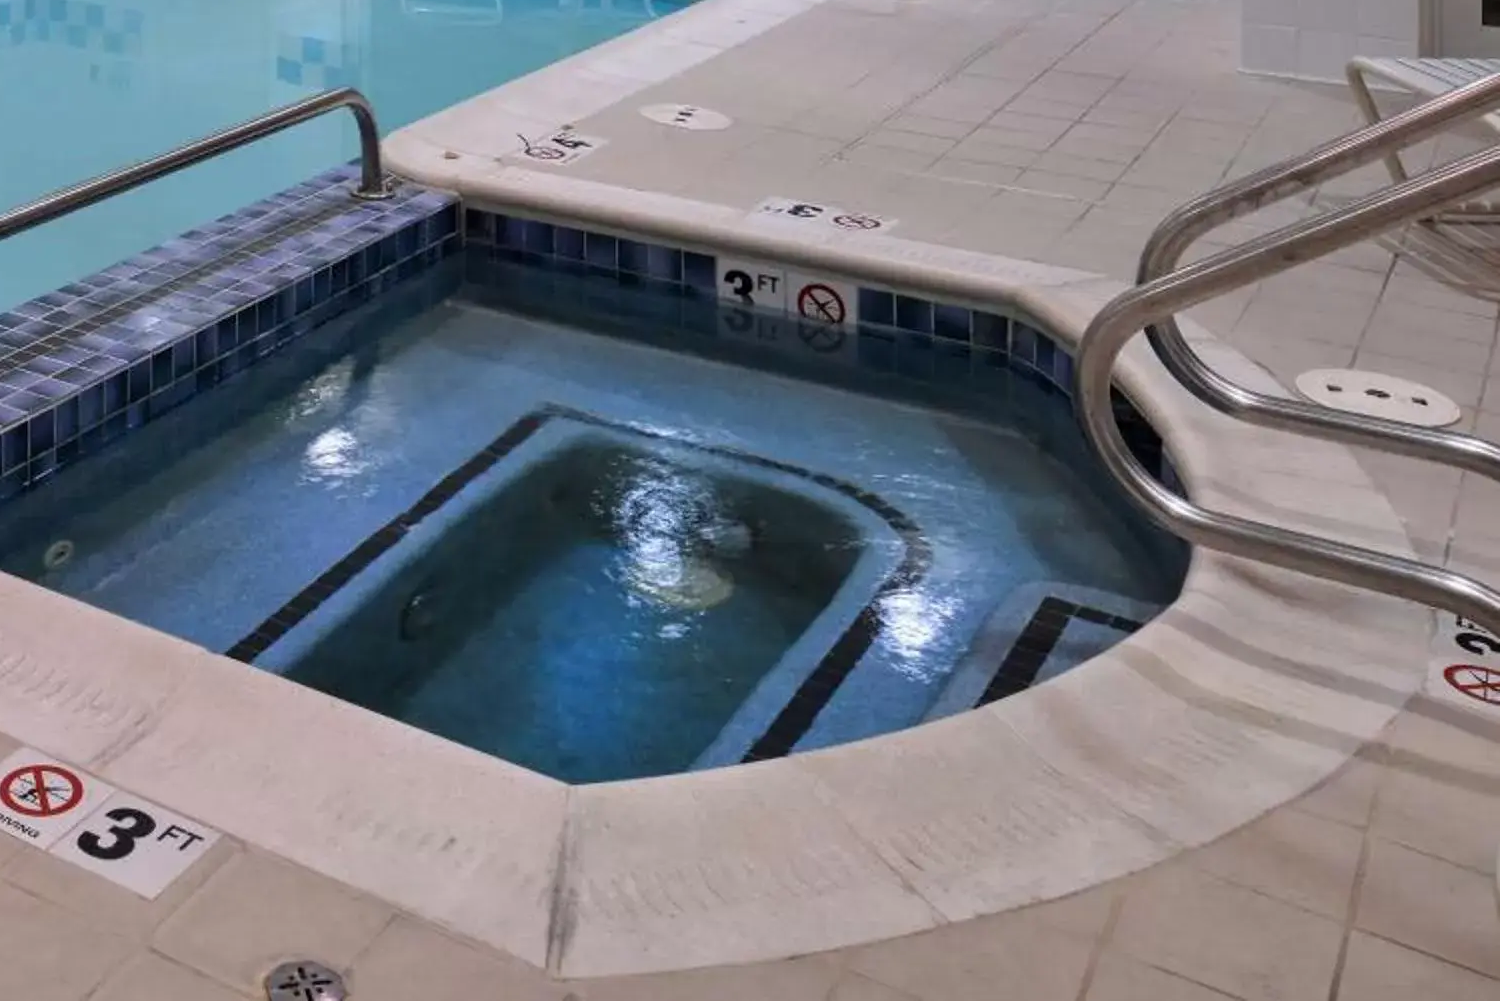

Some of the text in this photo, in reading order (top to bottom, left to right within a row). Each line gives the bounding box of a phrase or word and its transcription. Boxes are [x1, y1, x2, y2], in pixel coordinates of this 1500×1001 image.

[723, 269, 780, 306] 3 FT
[77, 807, 205, 860] 3 FT
